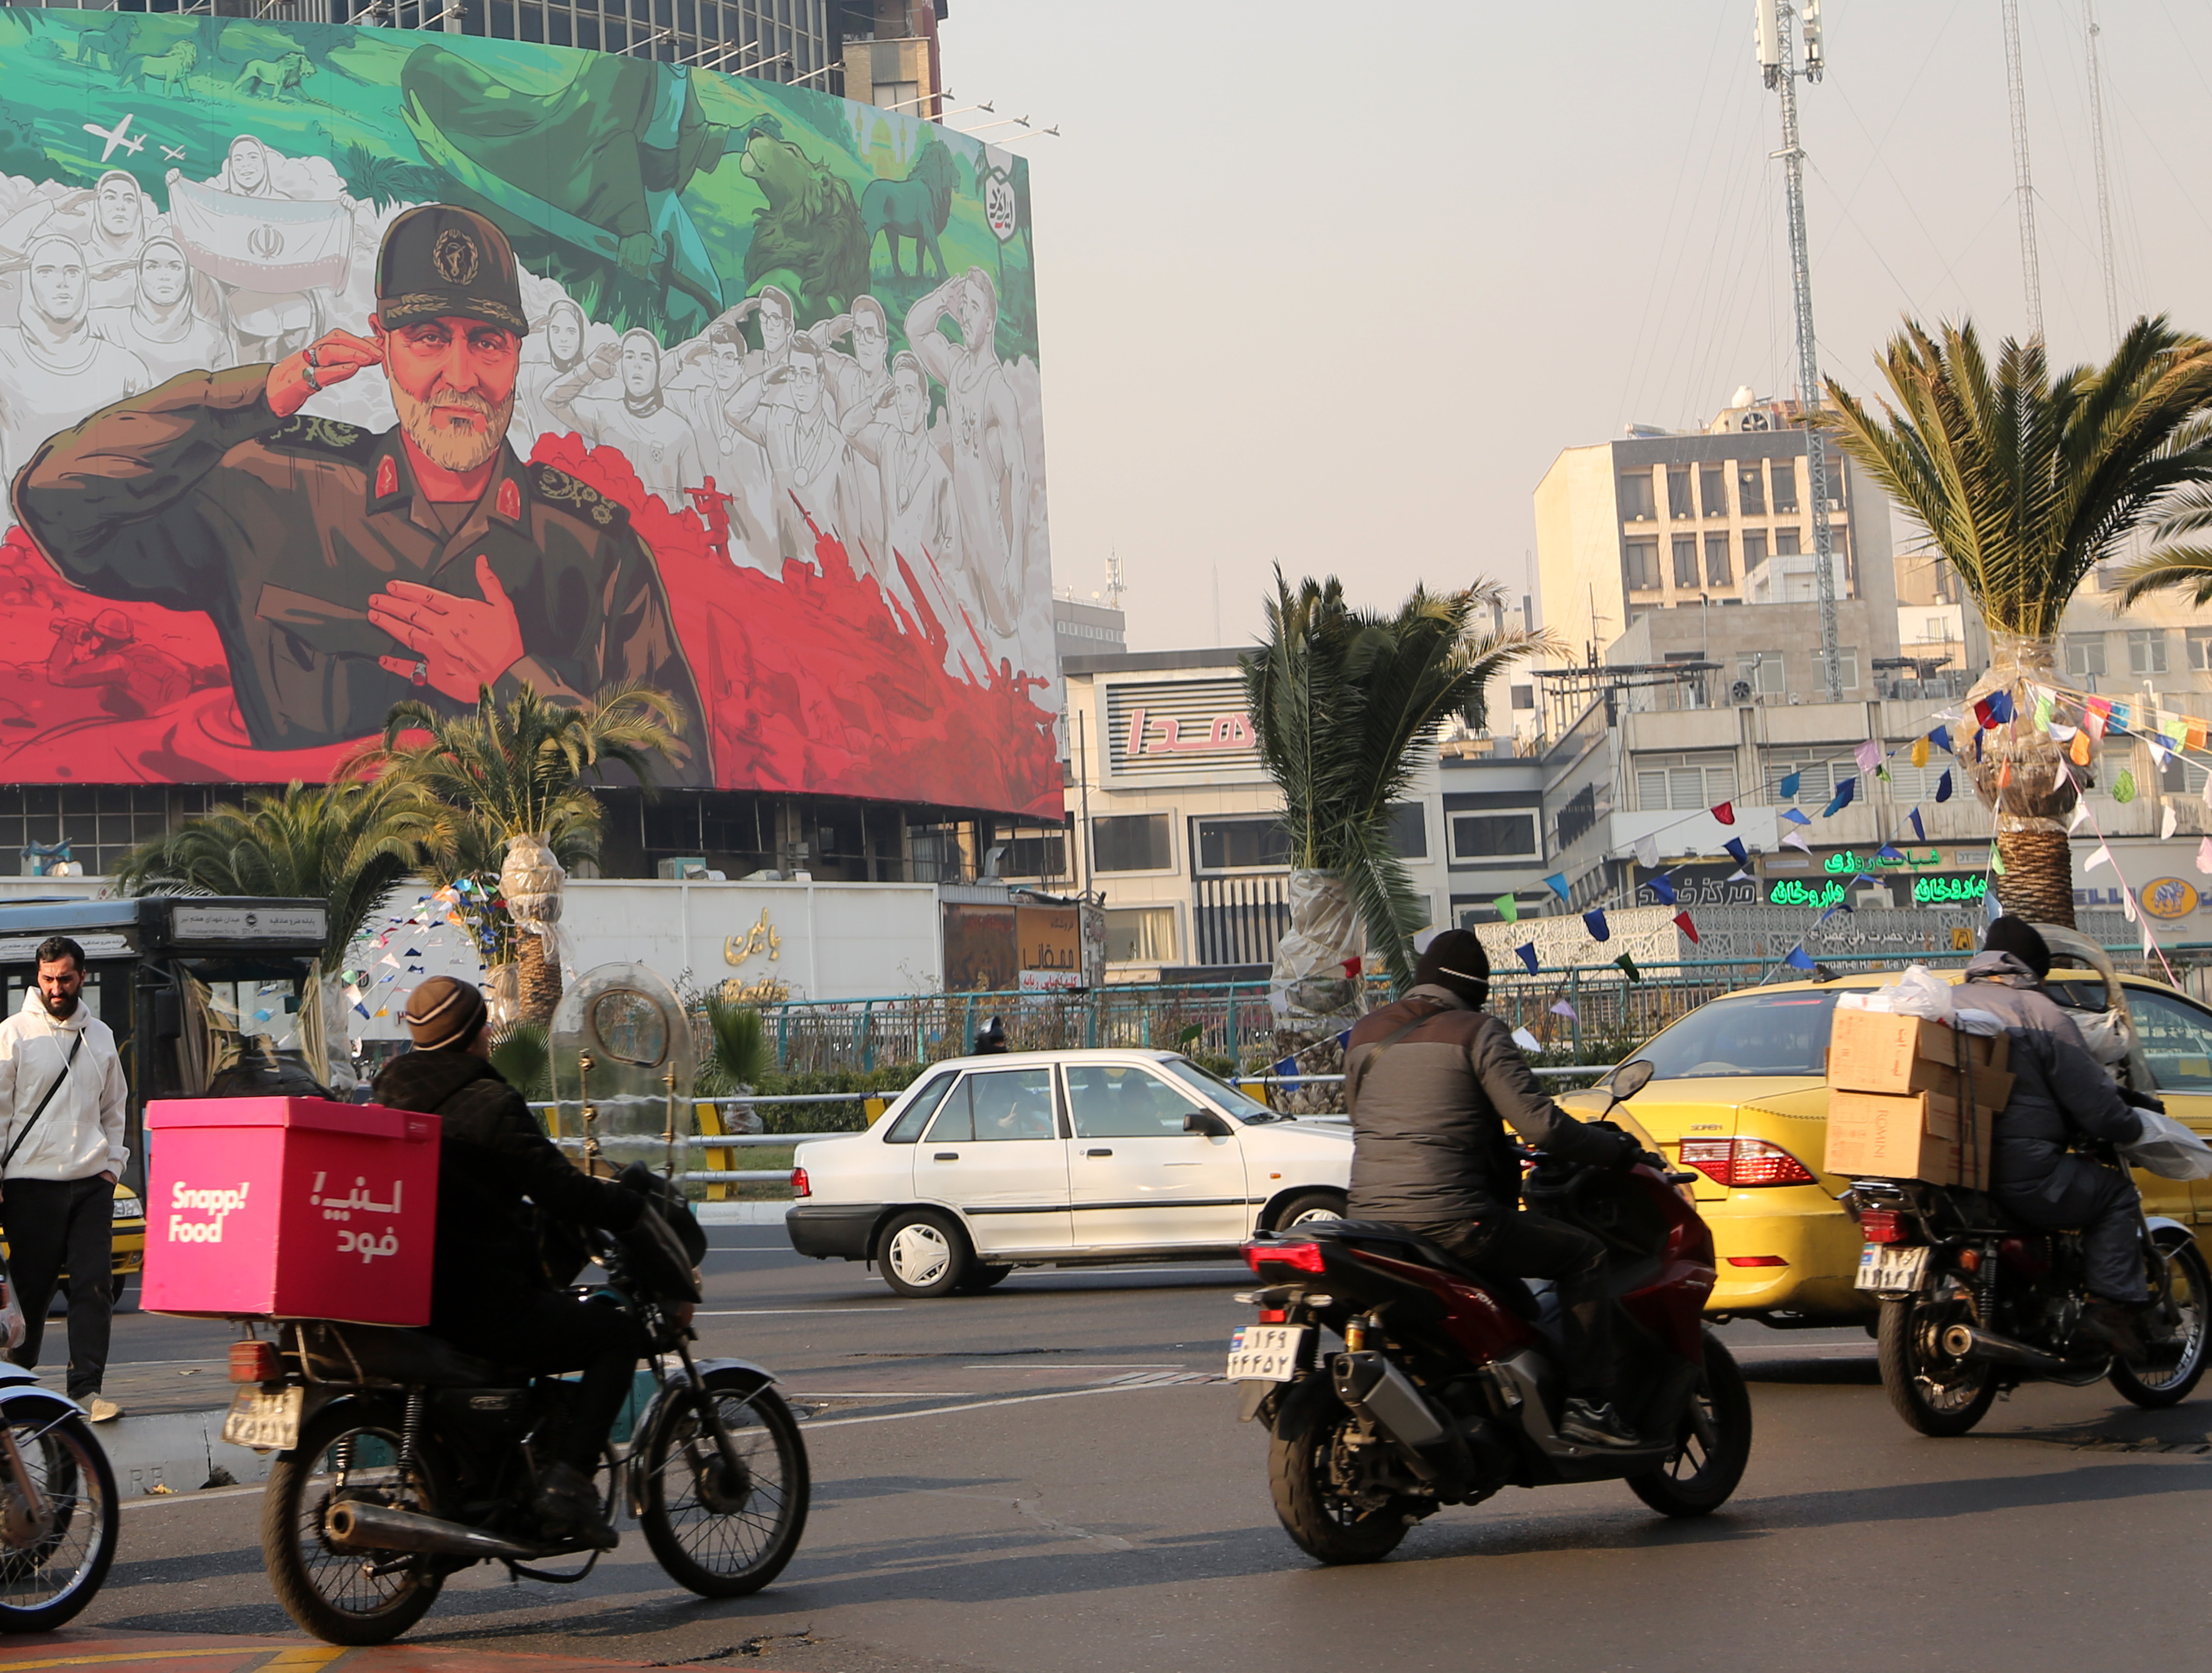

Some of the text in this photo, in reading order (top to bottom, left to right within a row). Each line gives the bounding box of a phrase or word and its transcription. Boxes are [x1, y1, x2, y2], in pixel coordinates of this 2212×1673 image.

[1769, 878, 1846, 908] داروخانه
[1914, 873, 1988, 902] داروخانه
[724, 907, 782, 966] بالین
[1873, 1109, 1889, 1158] ROMINI
[171, 1181, 250, 1217] Snapp!
[168, 1213, 223, 1243] Food
[336, 1226, 399, 1264] فود
